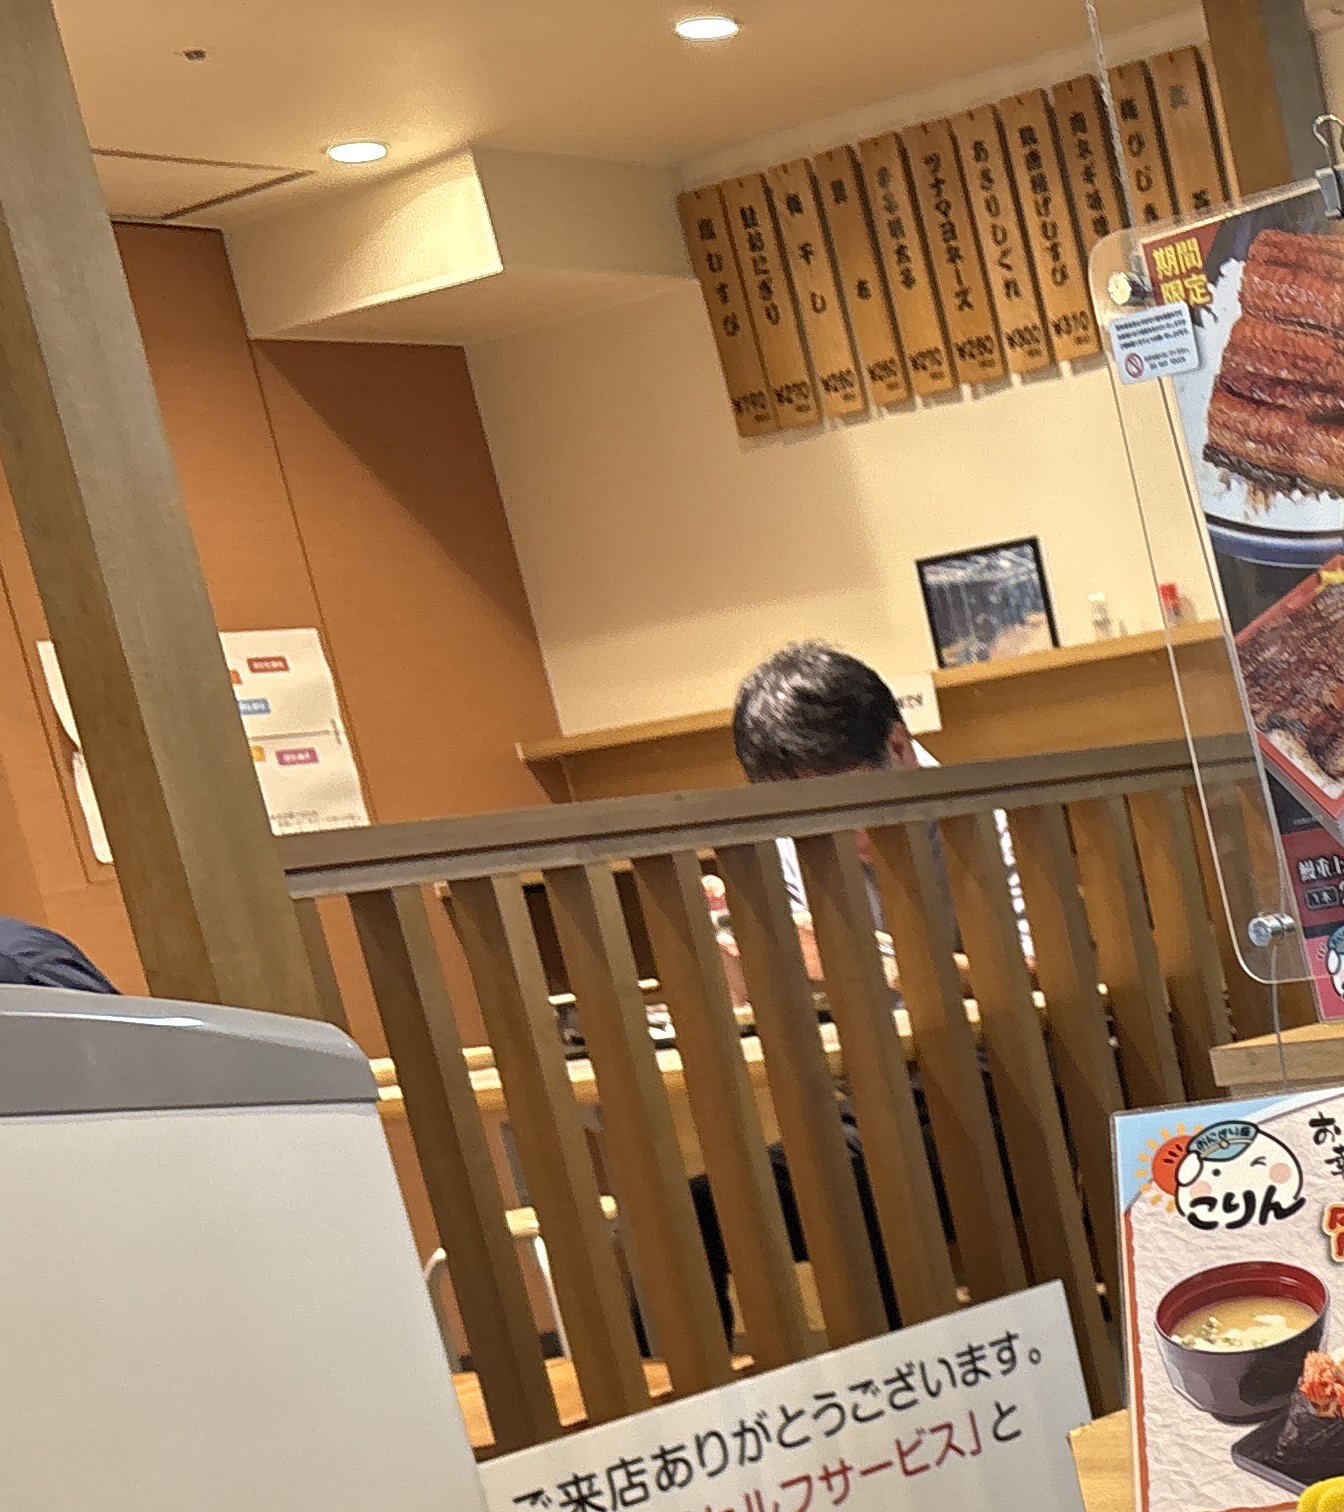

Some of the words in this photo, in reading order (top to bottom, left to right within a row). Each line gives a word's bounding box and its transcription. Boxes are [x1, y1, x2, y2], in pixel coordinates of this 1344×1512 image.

[1151, 237, 1203, 279] 期間
[1157, 276, 1213, 307] 限定
[1185, 1191, 1307, 1232] こりん
